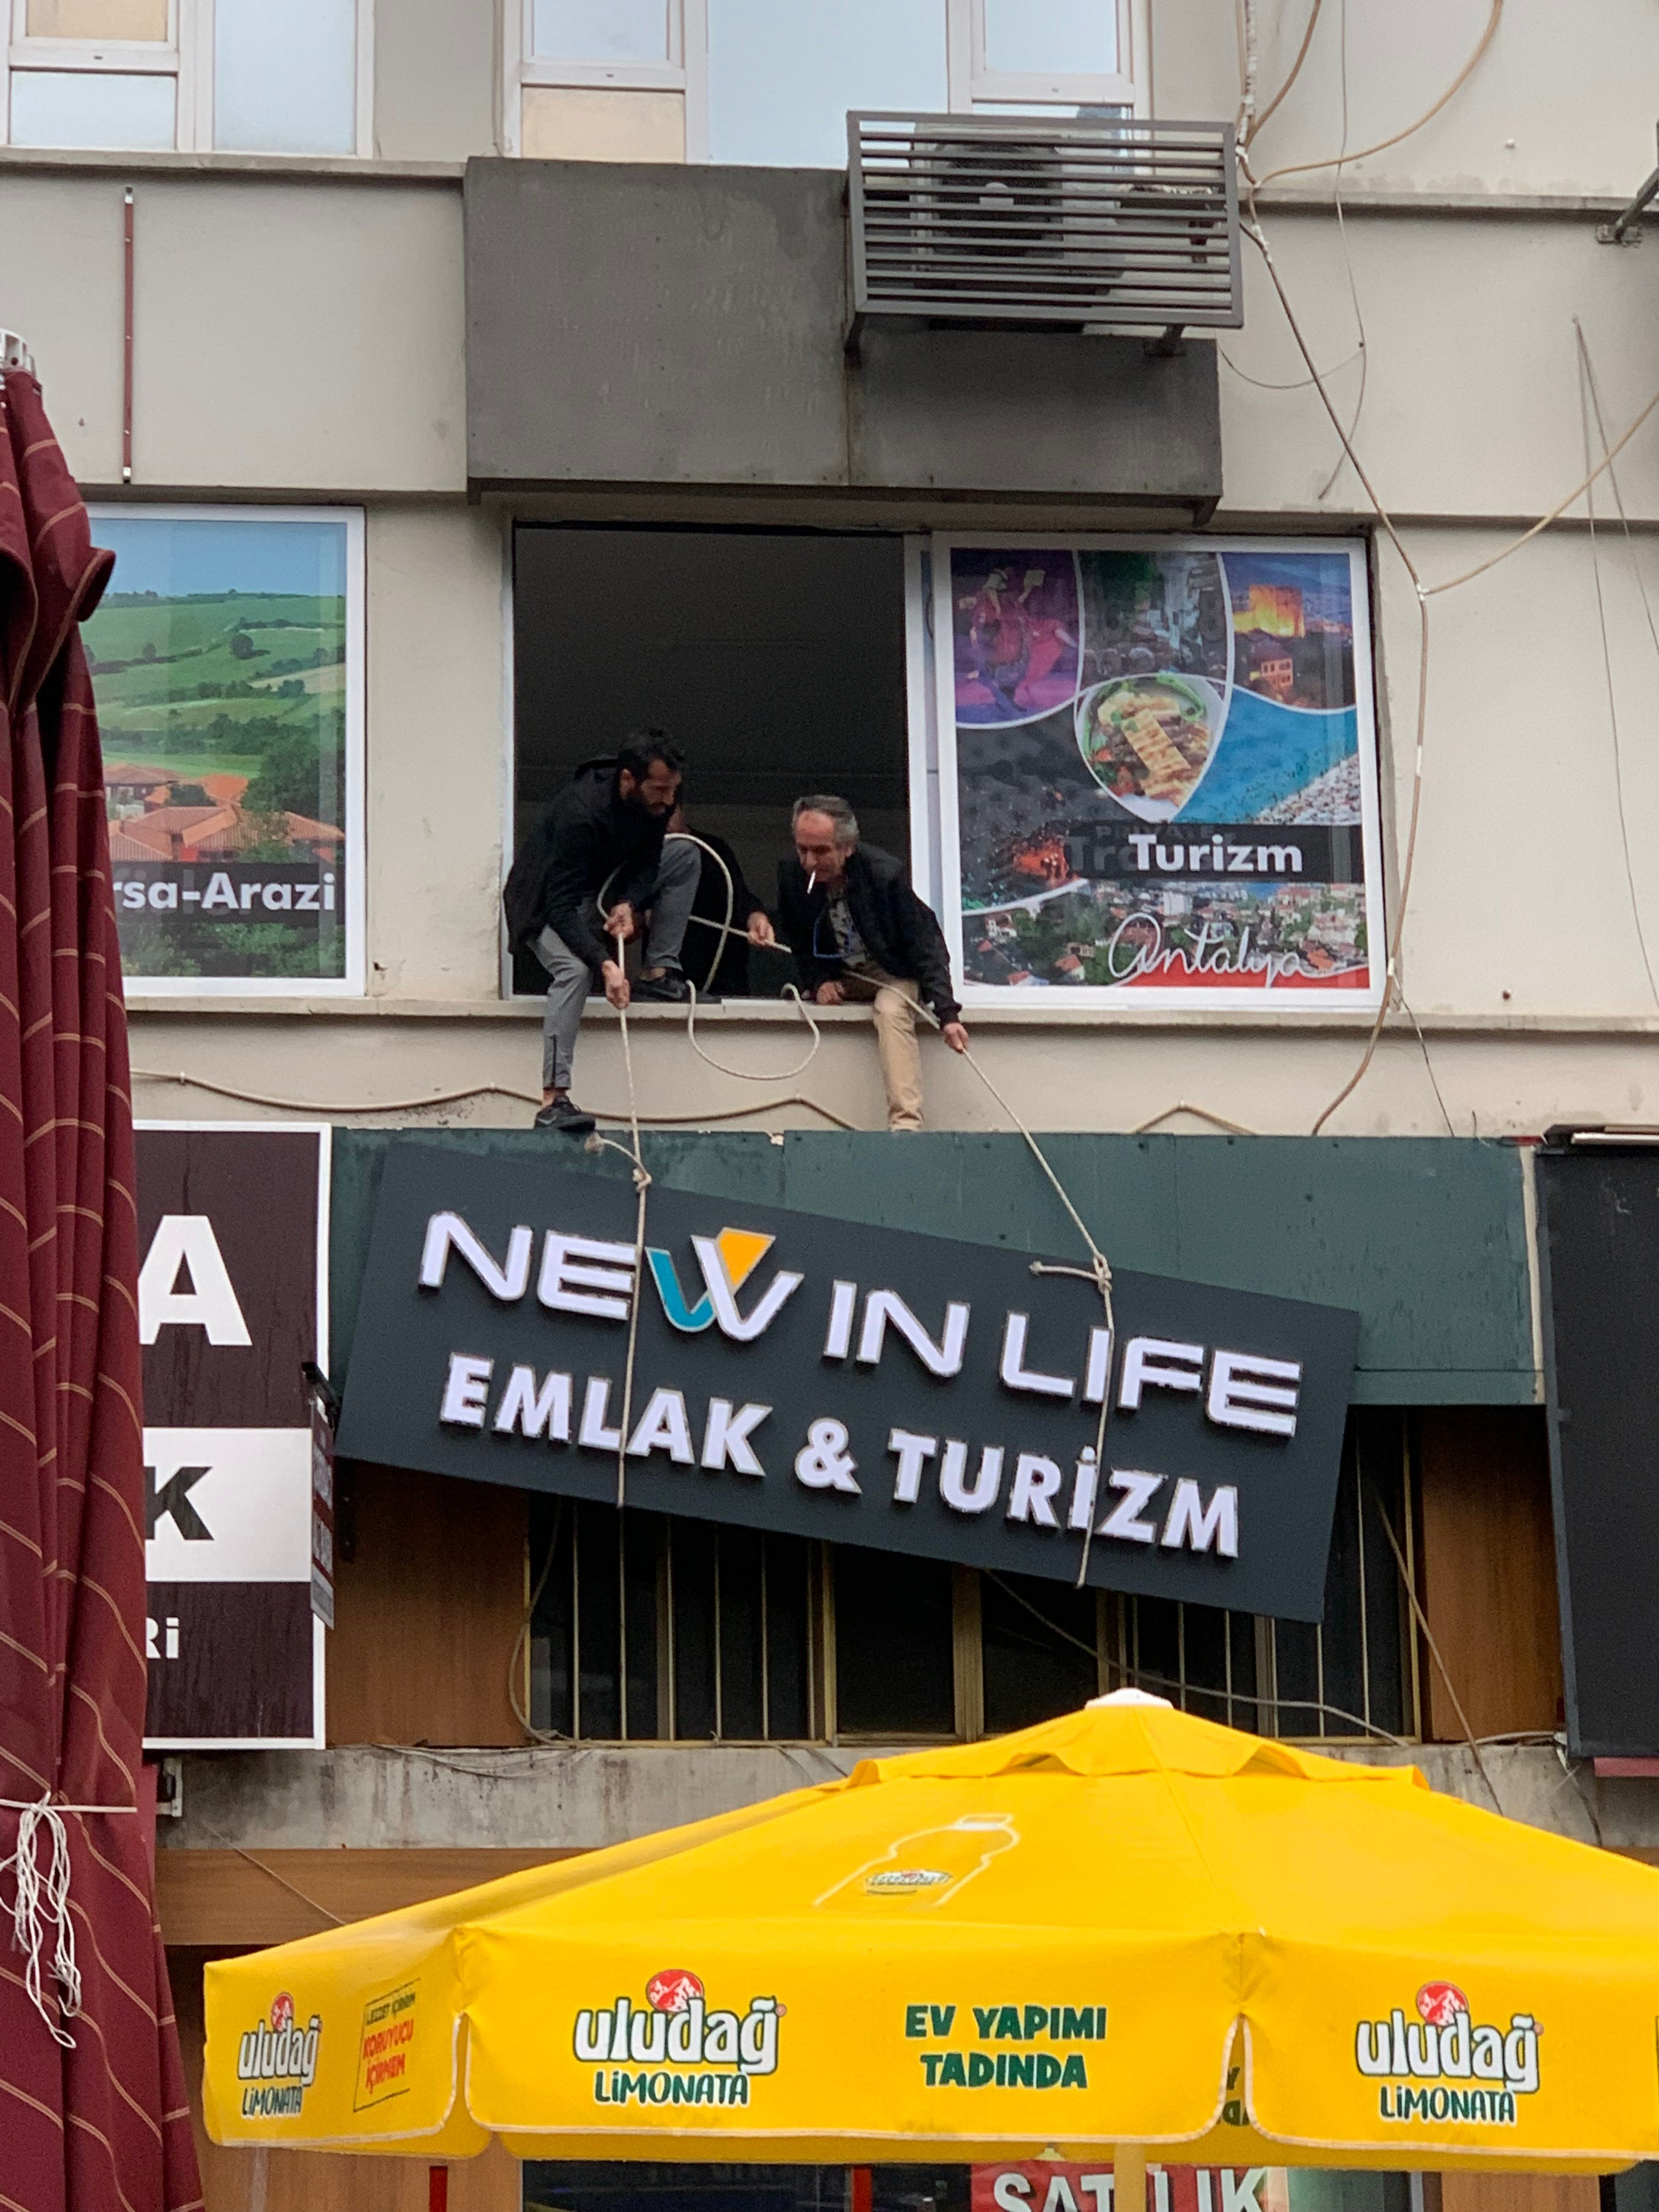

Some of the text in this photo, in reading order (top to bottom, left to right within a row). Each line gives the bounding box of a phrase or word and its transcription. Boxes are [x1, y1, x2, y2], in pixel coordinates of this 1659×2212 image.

[1128, 834, 1303, 873] Turizm
[418, 1210, 1303, 1438] NEW IN LIFE
[439, 1351, 773, 1478] EMLAK
[795, 1417, 863, 1495] &
[238, 2014, 320, 2088] uludağ
[574, 1995, 778, 2075] uludağ
[905, 2004, 1107, 2040] EV YAPIMI
[1355, 2008, 1540, 2095] uludağ
[920, 2052, 1088, 2090] TADINDA
[993, 2168, 1268, 2212] SATLIK
